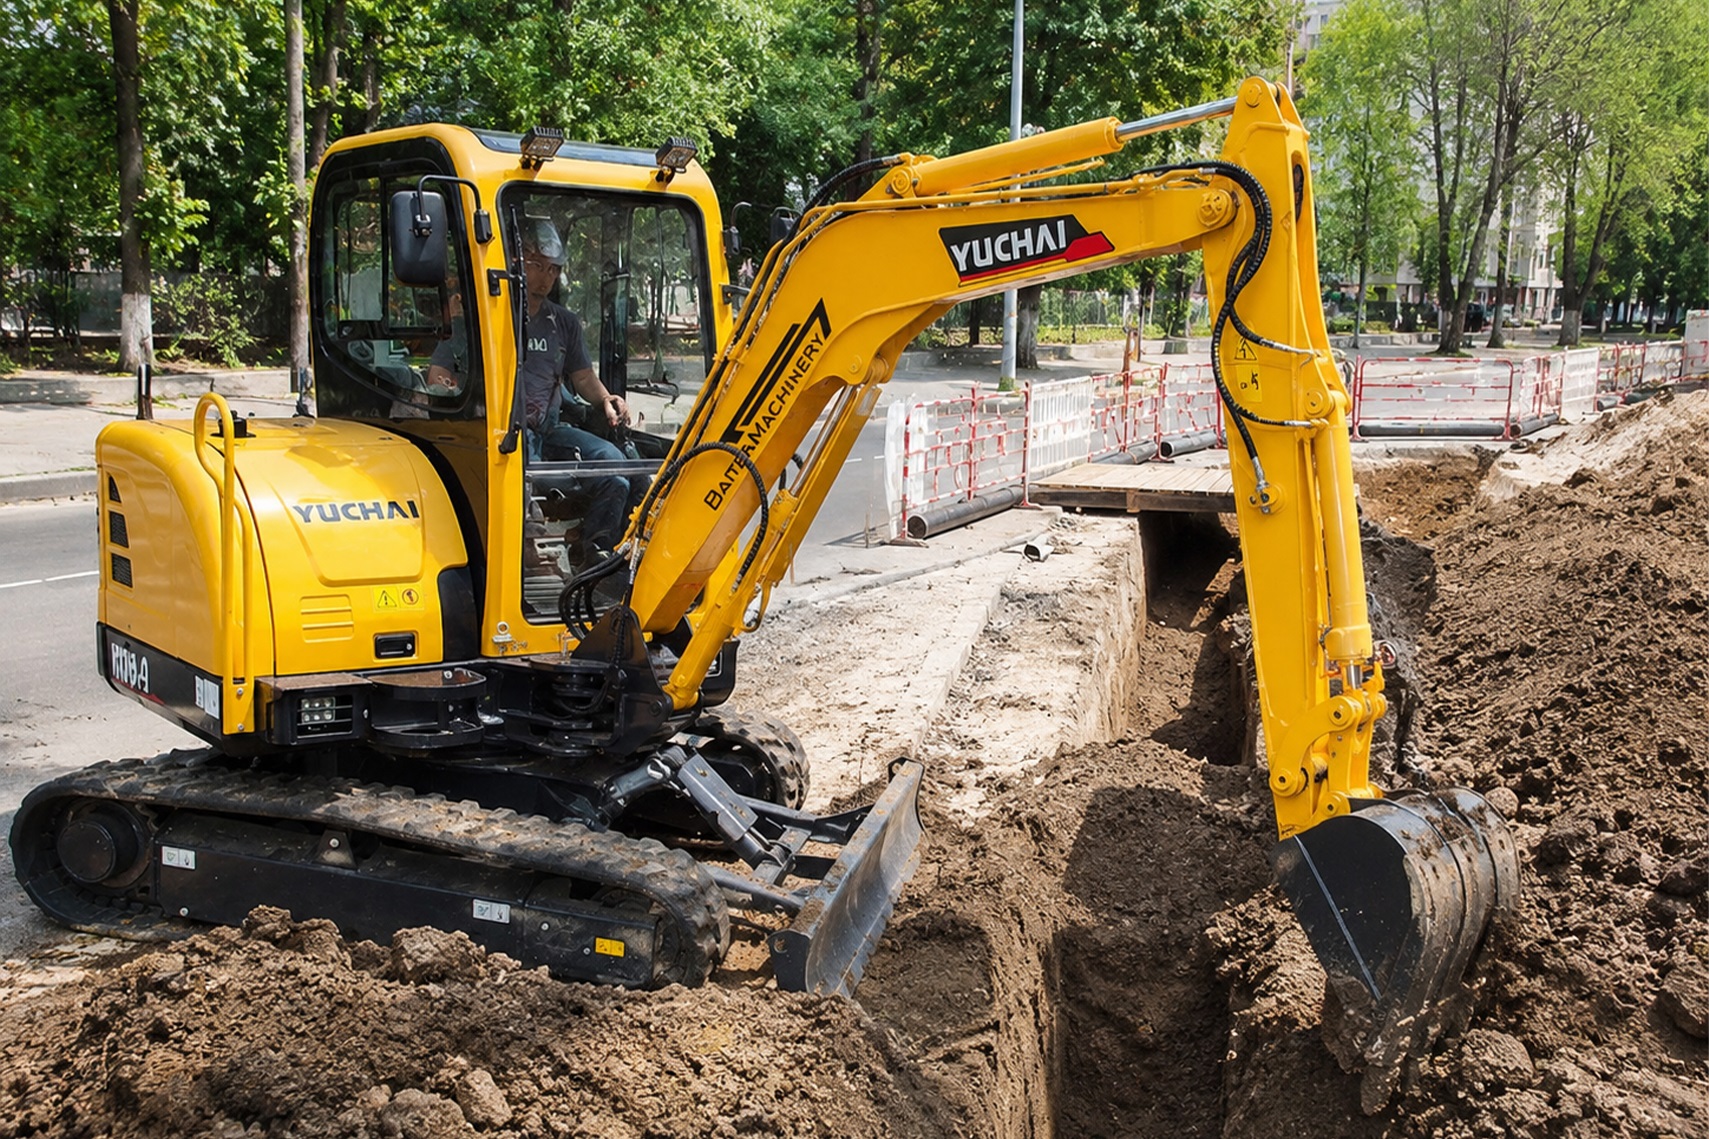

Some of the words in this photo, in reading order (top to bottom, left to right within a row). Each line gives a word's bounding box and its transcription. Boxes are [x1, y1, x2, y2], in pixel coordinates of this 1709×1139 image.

[950, 219, 1066, 272] YUCHAI
[747, 332, 824, 446] MACHINERY
[293, 500, 420, 523] YUCHAI
